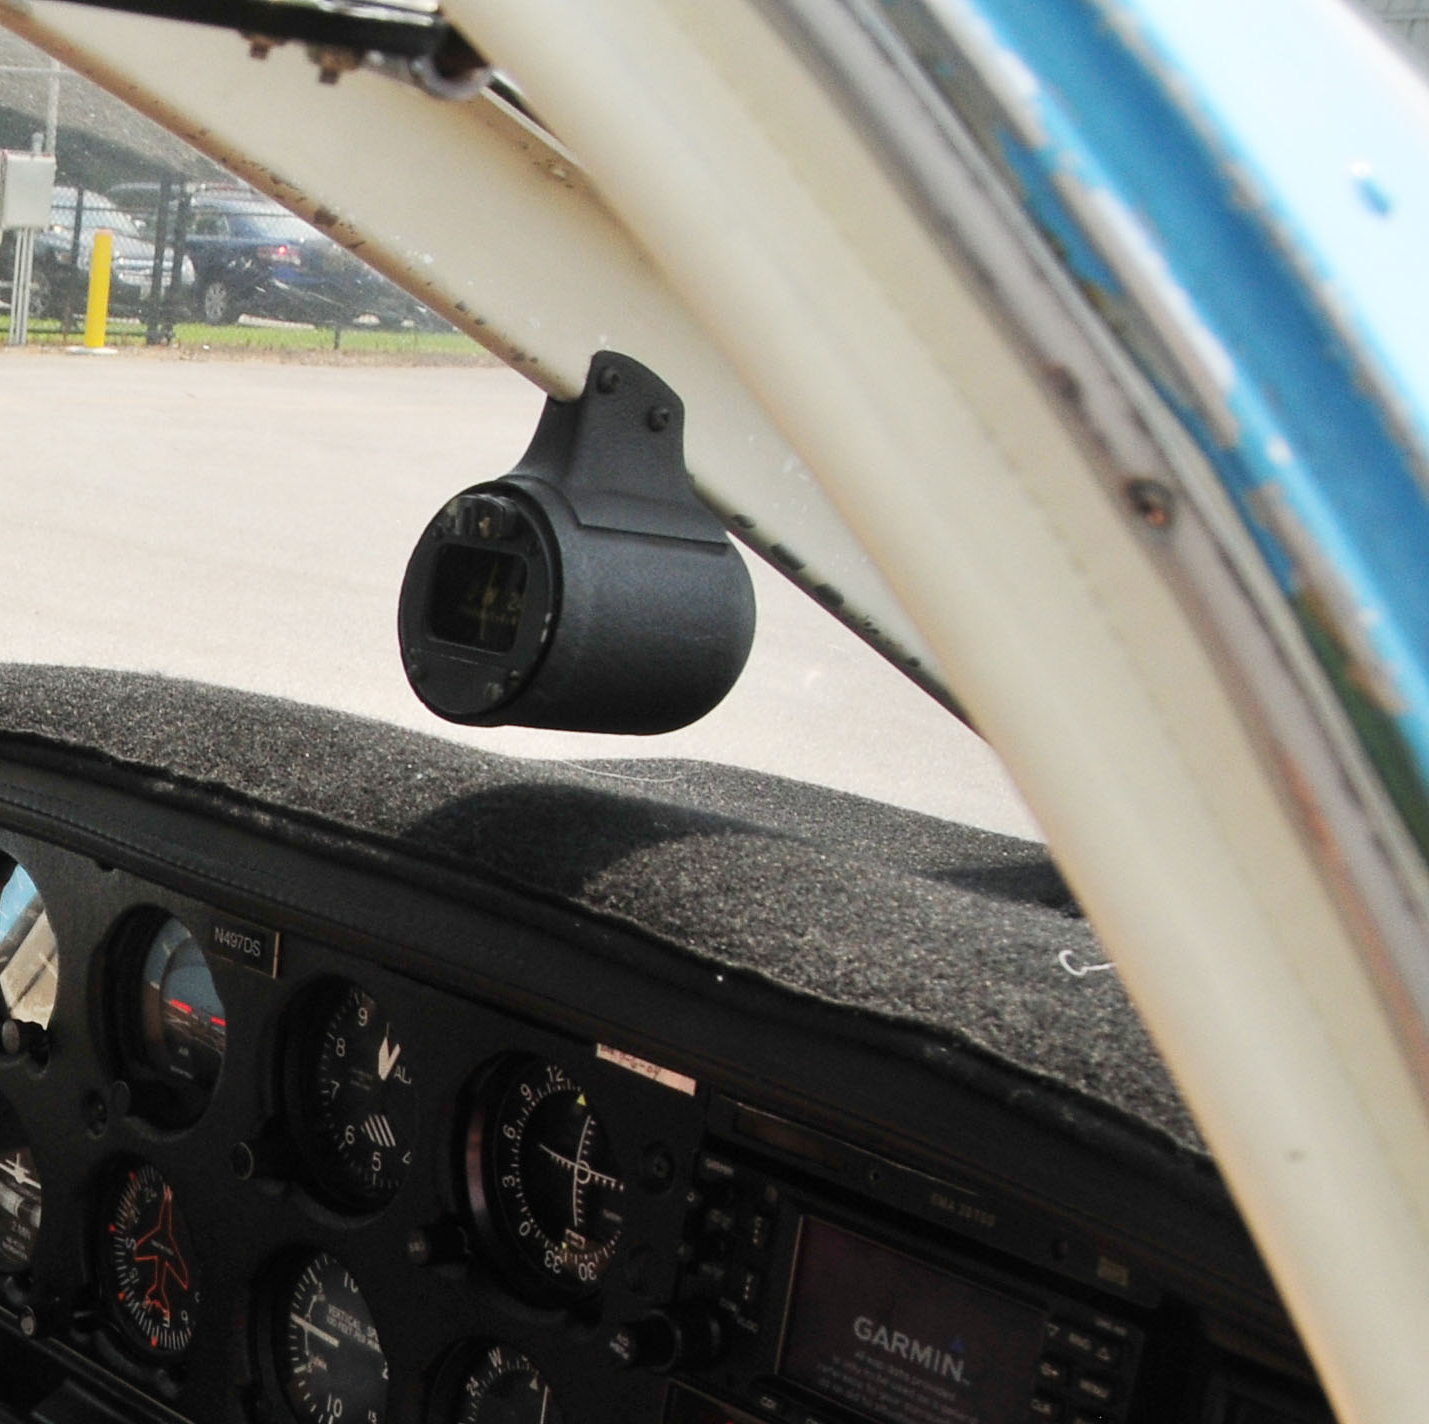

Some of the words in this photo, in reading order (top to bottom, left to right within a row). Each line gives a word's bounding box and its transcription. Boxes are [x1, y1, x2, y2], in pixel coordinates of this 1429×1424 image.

[213, 927, 262, 957] N497DS
[546, 1064, 564, 1083] 12
[520, 1083, 533, 1101] 9
[345, 1125, 355, 1145] 6
[372, 1152, 382, 1172] 5
[501, 1174, 515, 1188] 3
[543, 1248, 563, 1275] 33
[852, 1315, 965, 1383] GARMIN
[327, 1393, 343, 1419] 10
